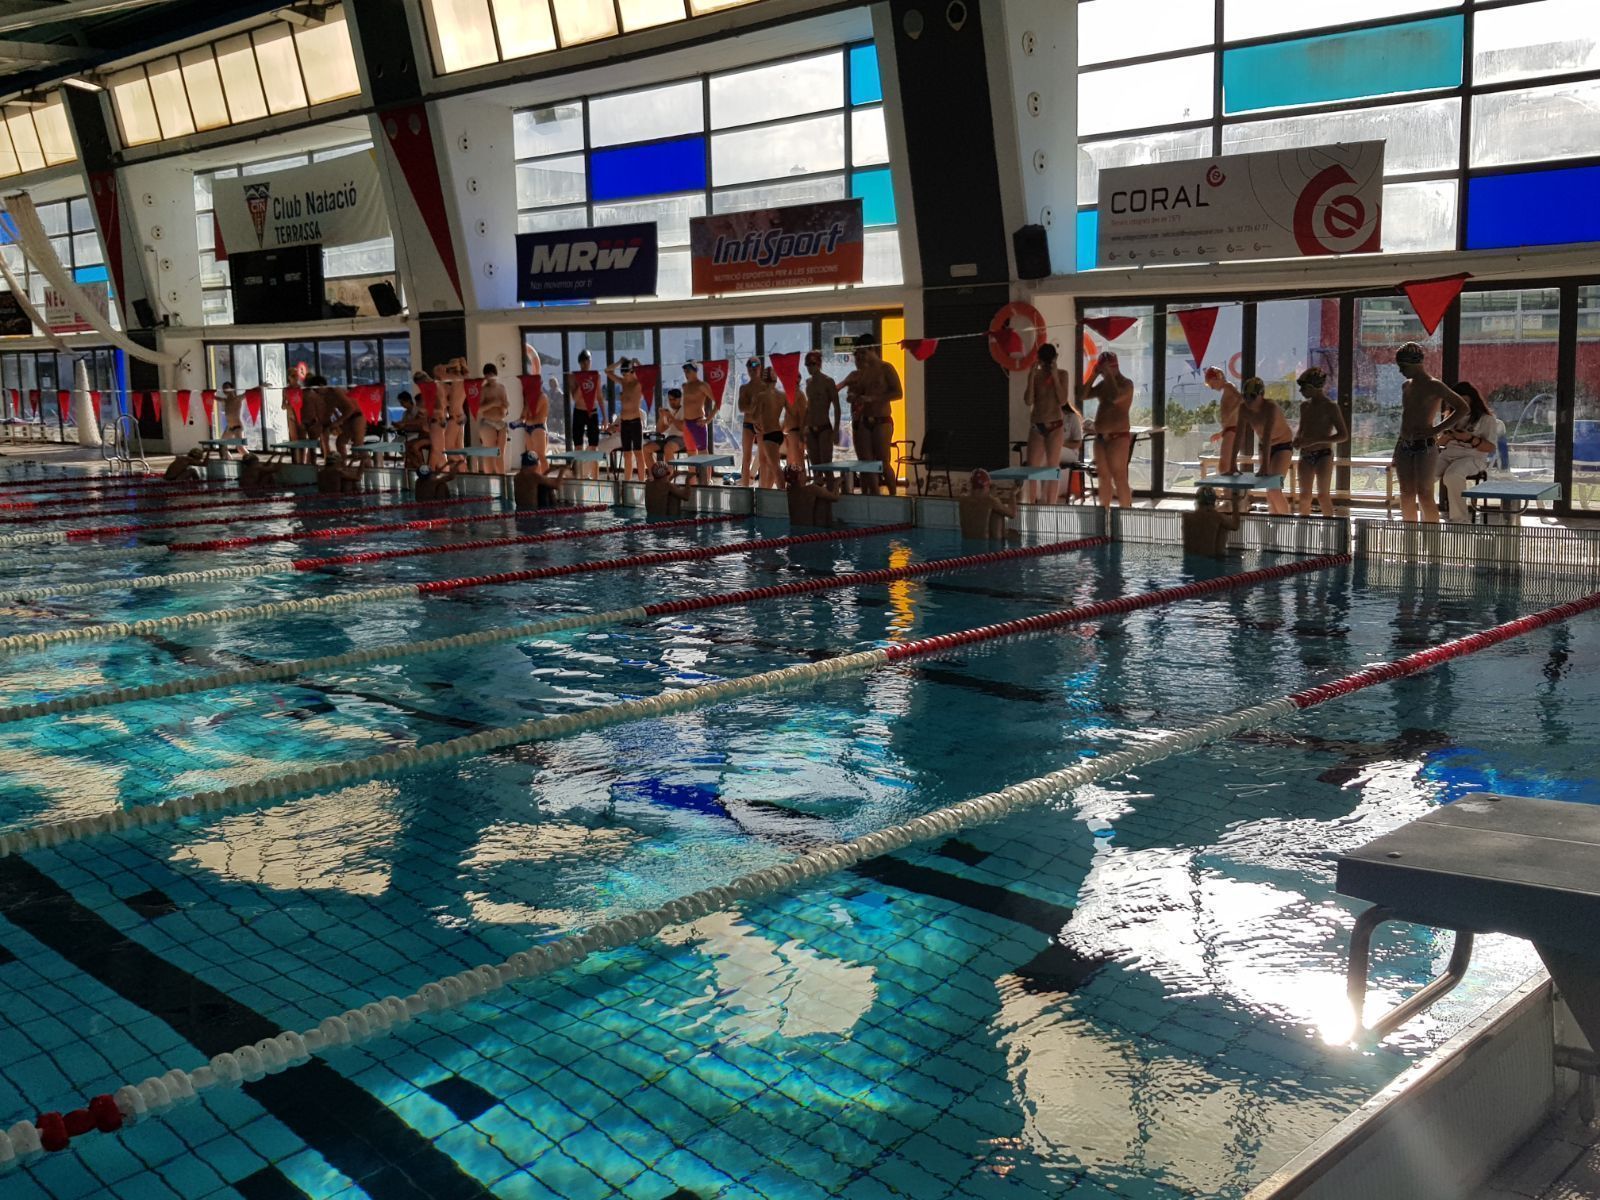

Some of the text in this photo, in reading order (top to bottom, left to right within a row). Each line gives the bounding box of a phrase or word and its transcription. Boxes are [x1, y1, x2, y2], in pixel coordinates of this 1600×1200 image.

[273, 181, 357, 220] Club Natació
[1110, 184, 1210, 214] CORAL
[274, 221, 322, 245] TERRASSA
[712, 222, 845, 267] InfiSport
